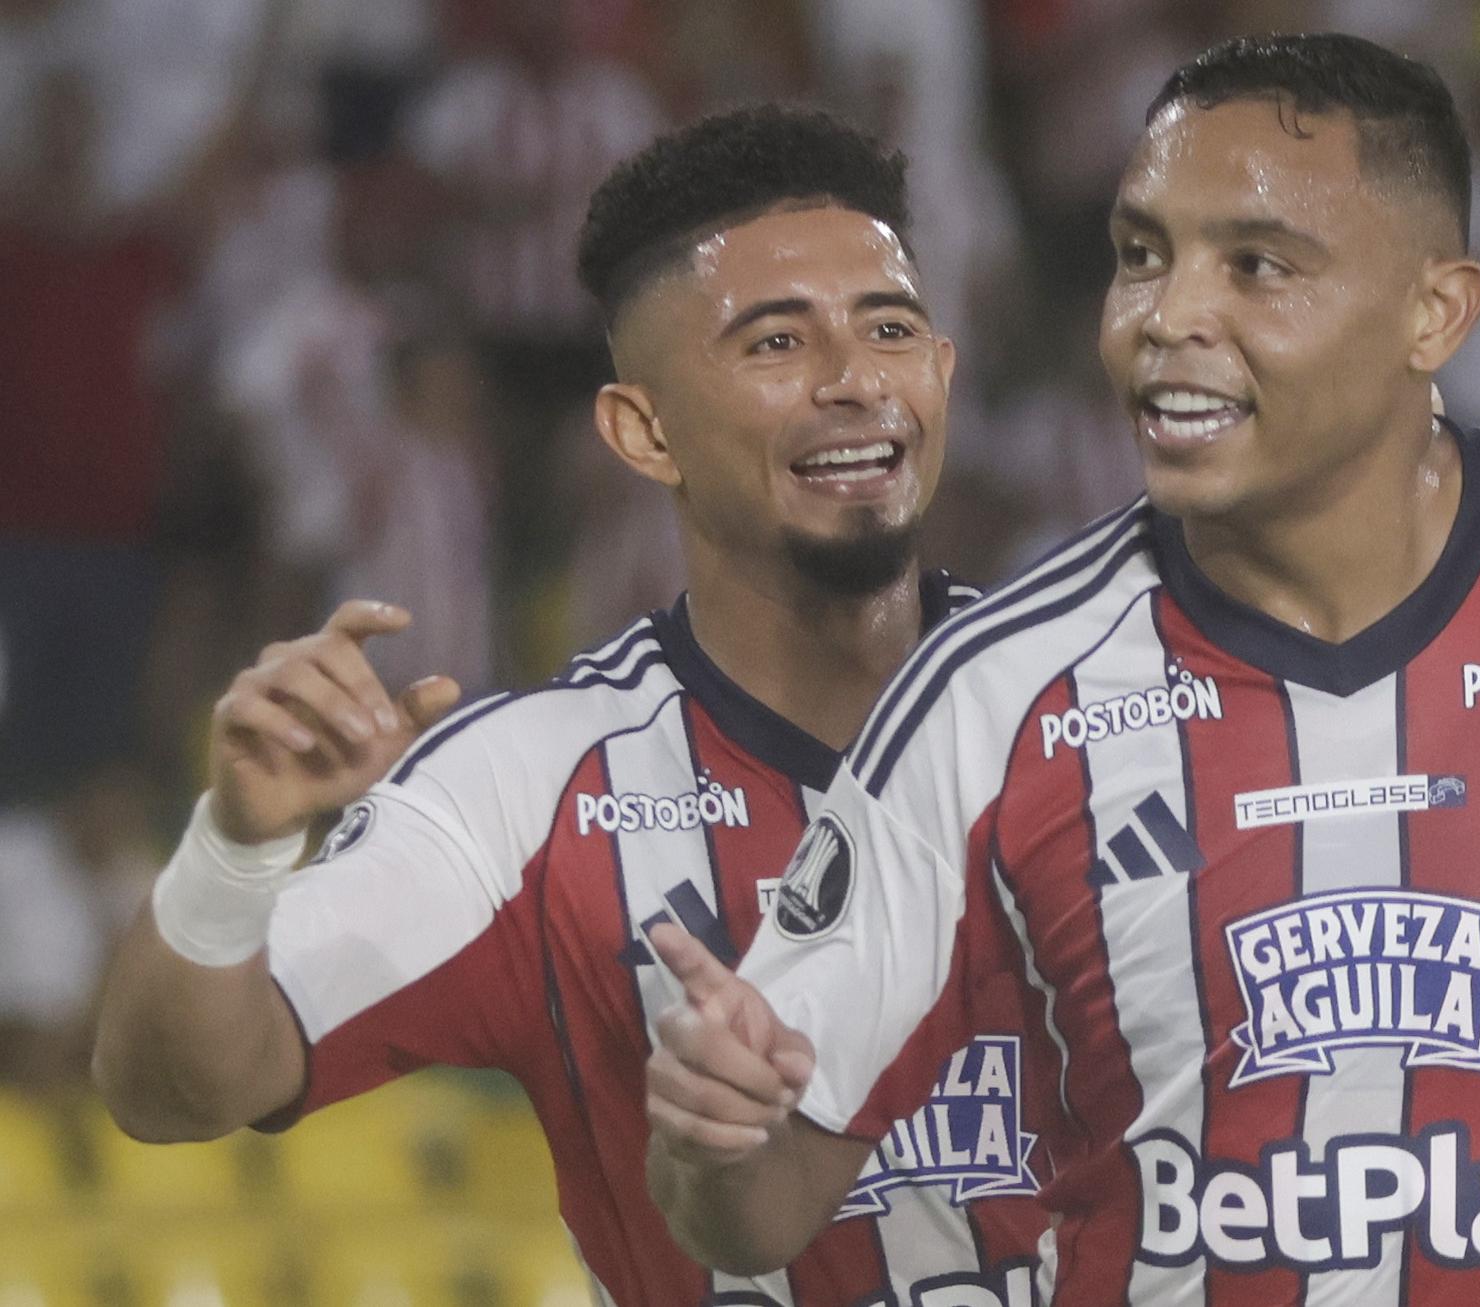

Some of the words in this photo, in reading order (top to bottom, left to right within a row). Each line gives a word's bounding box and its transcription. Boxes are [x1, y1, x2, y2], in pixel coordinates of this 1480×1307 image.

[1236, 783, 1427, 821] TECNOGLASS
[1260, 962, 1476, 1050] AGUILA
[857, 1103, 1014, 1181] UILA
